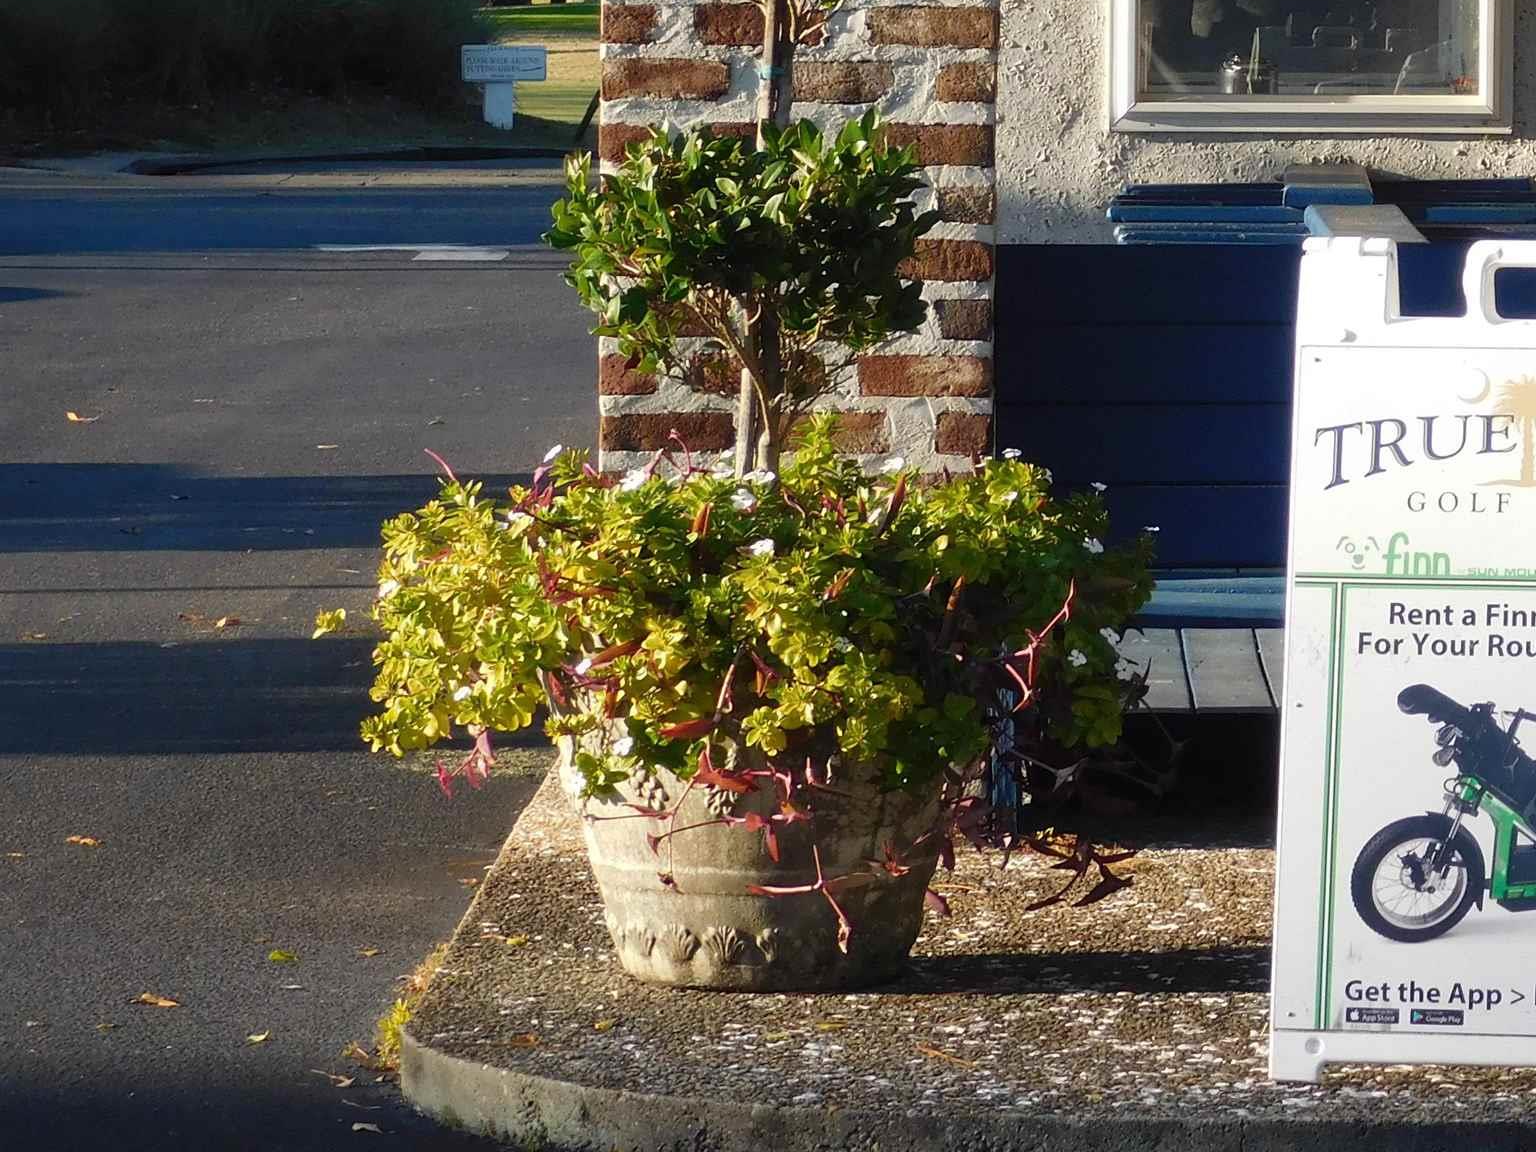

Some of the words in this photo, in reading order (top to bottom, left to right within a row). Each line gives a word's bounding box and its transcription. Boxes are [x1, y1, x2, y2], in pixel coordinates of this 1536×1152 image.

[1314, 414, 1517, 491] TRUE
[1407, 491, 1512, 514] GOLF
[1382, 532, 1451, 576] finn
[1467, 567, 1499, 577] SUN
[1389, 602, 1454, 626] Rent
[1462, 609, 1476, 626] a
[1358, 631, 1404, 655] For
[1412, 632, 1480, 657] Your
[1344, 979, 1391, 1003] Get
[1397, 980, 1441, 1004] the
[1447, 982, 1502, 1011] App
